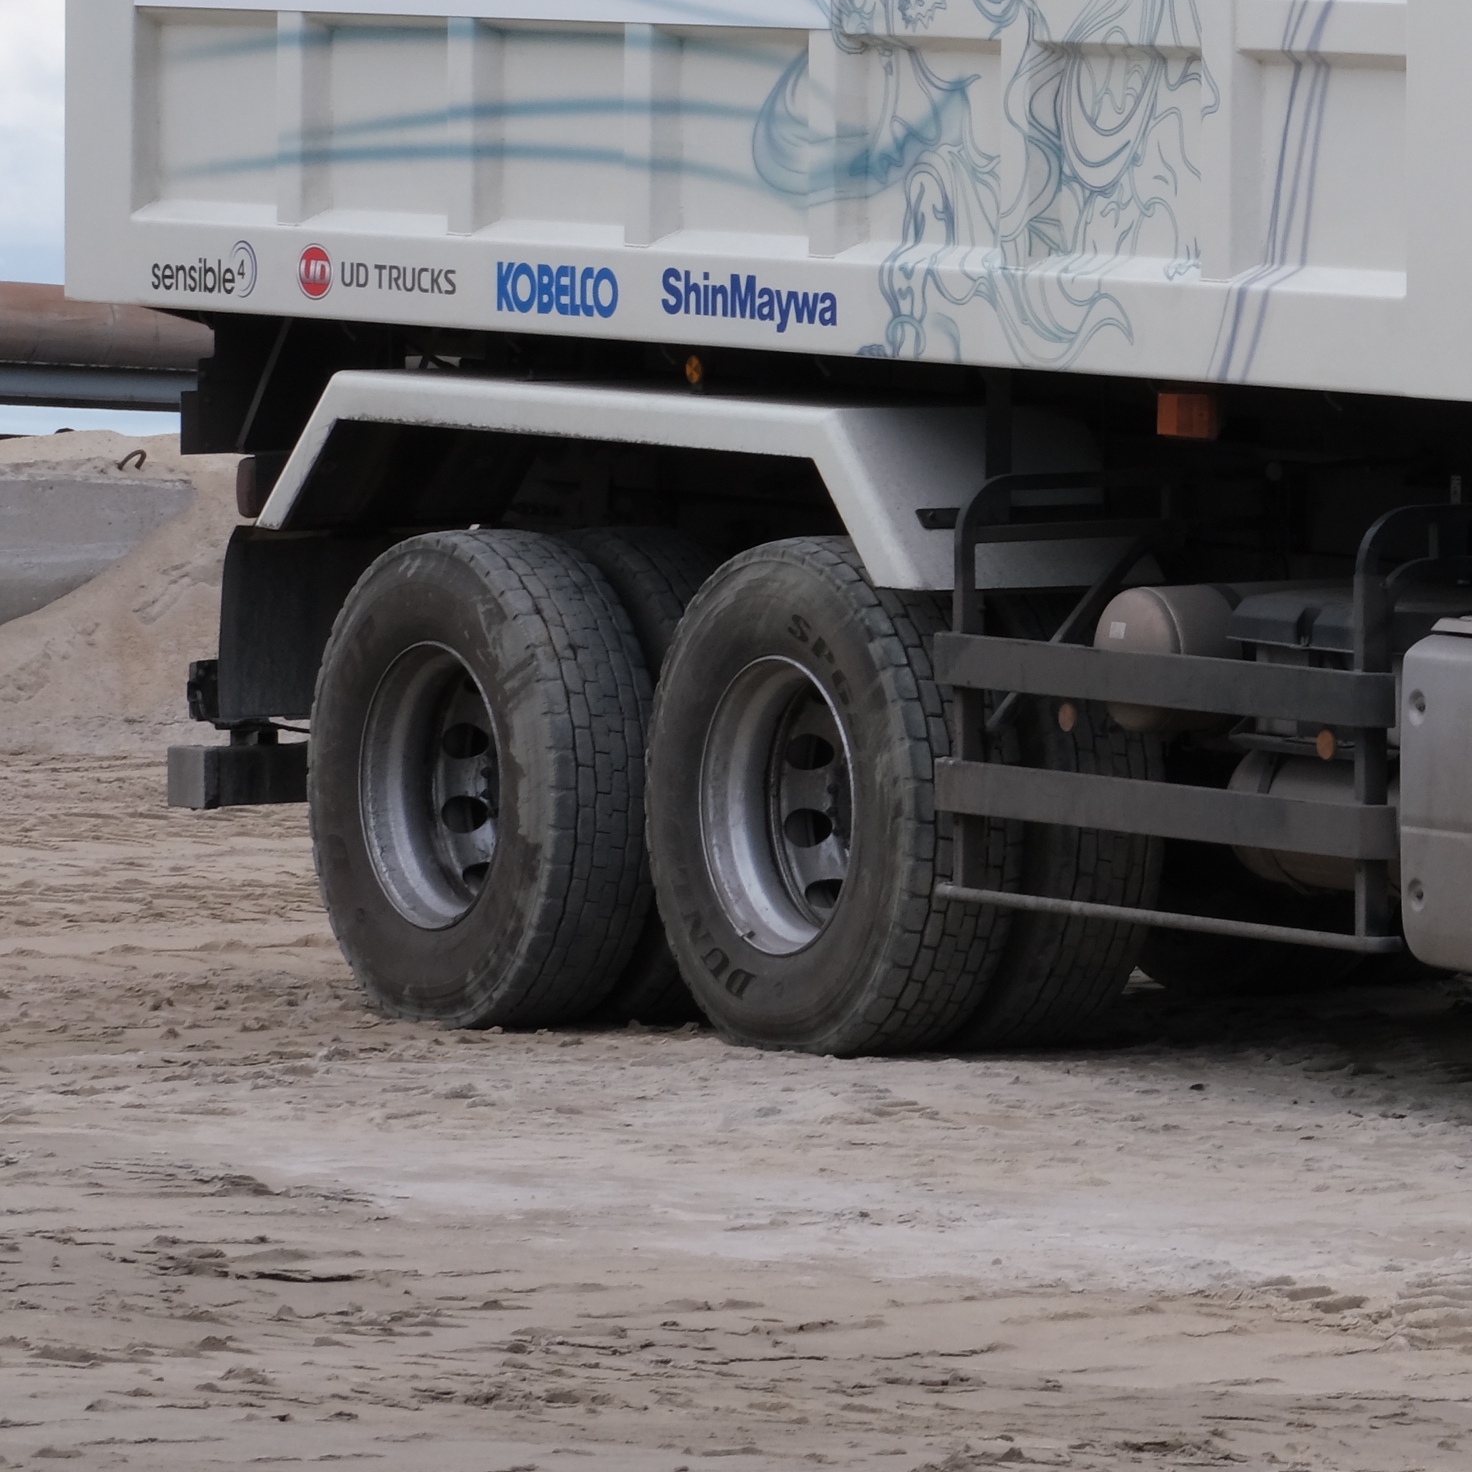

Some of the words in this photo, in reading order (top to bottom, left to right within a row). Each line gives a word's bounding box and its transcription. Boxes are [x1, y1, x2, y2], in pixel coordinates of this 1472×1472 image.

[340, 261, 369, 288] UD
[374, 264, 457, 295] TRUCKS
[496, 261, 619, 318] KOBELCO
[661, 267, 837, 333] ShinMaywa
